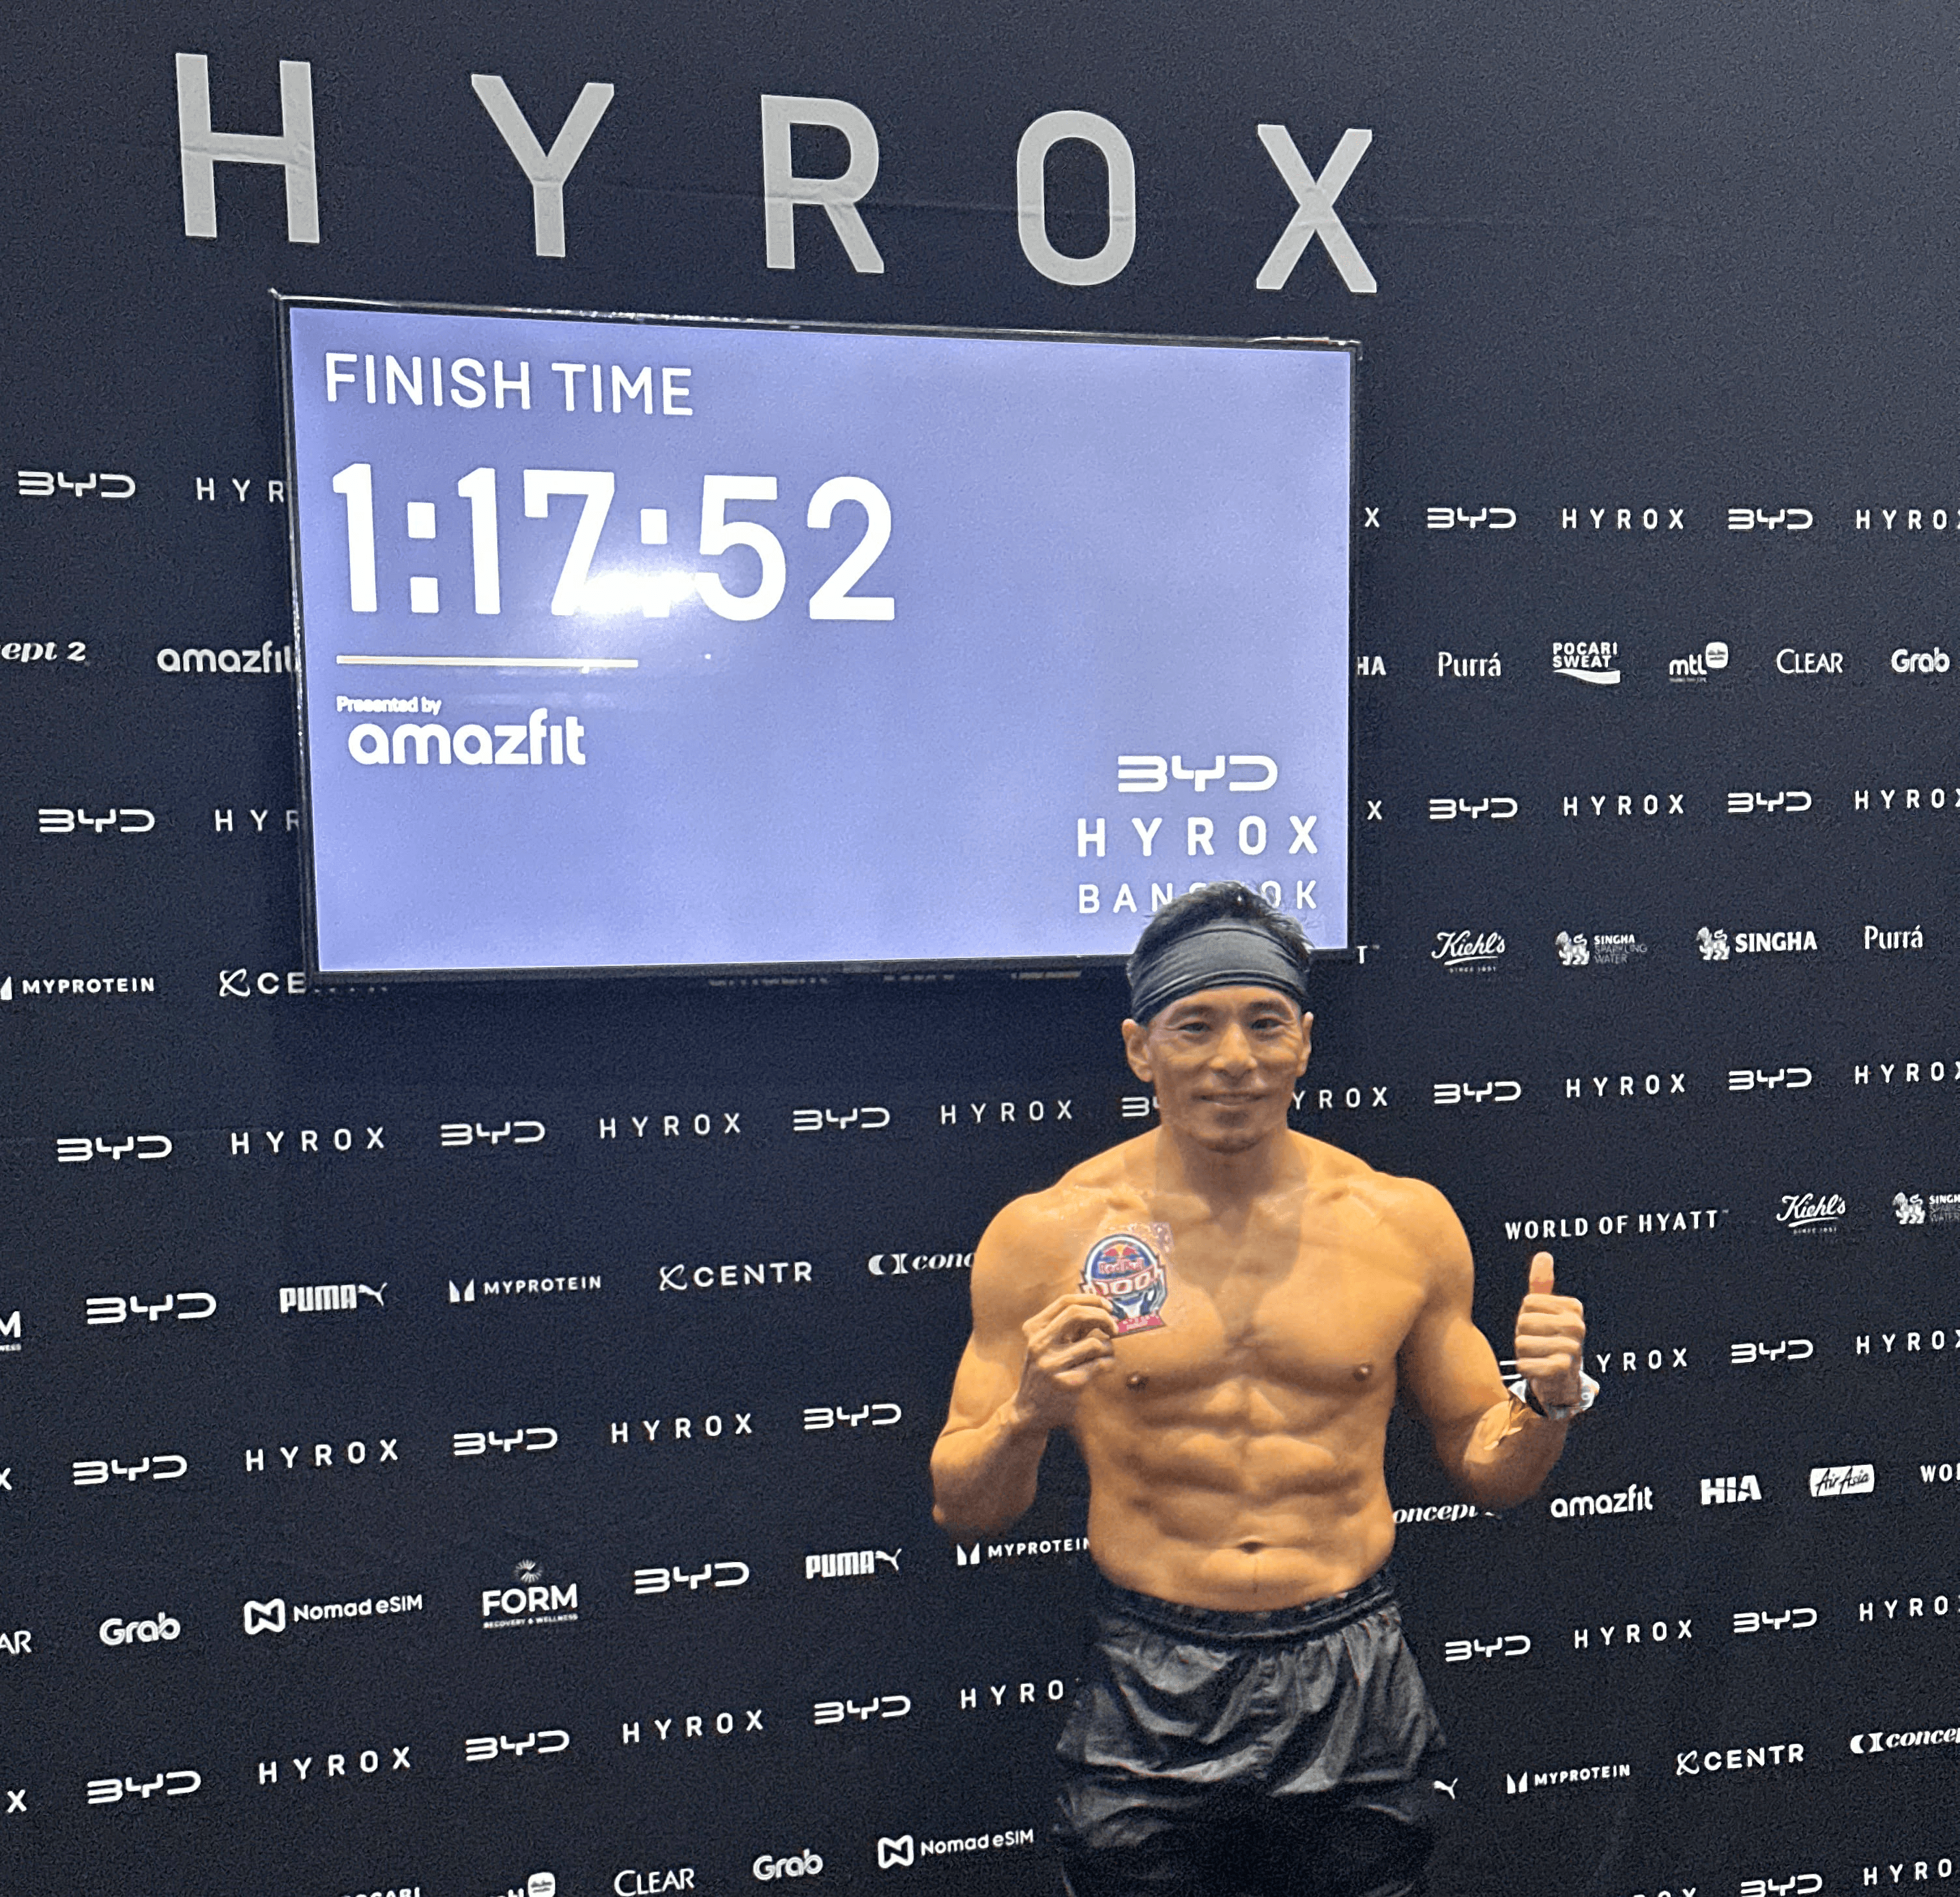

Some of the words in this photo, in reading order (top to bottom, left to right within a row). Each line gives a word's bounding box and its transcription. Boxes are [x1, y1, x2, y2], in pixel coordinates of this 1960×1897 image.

[175, 53, 1377, 293] HYROX
[326, 353, 531, 411] FINISH
[552, 362, 693, 416] TIME
[18, 471, 136, 498] BYD
[196, 477, 285, 503] HYR
[1427, 507, 1516, 529] BYD
[1563, 508, 1684, 530] HYROX
[1728, 508, 1813, 531] BYD
[1856, 509, 1960, 530] HYRO
[332, 463, 896, 622] 1:17:52
[67, 642, 85, 661] 2
[1553, 642, 1618, 655] POCARI
[1553, 656, 1613, 668] SWEAT
[1776, 648, 1843, 674] CLEAR
[1891, 647, 1950, 673] Grab
[1438, 652, 1501, 677] Purrá
[422, 697, 442, 716] by
[348, 708, 586, 766] amazfit
[1117, 755, 1278, 792] BYD
[1430, 798, 1518, 819] BYD
[1564, 794, 1683, 817] HYROX
[1727, 791, 1811, 813] BYD
[38, 809, 155, 833] BYD
[216, 809, 299, 832] HYR
[1076, 815, 1318, 857] HYROX
[1079, 880, 1317, 914] BANOK
[1431, 930, 1505, 959] Kiehl's
[1594, 934, 1635, 945] SINGHA
[1735, 931, 1817, 953] SINGHA
[1865, 925, 1923, 949] Purrá
[23, 977, 154, 994] MYPROTEIN
[57, 1135, 172, 1162] BYD
[231, 1127, 384, 1155] HYROX
[440, 1121, 545, 1146] BYD
[600, 1113, 740, 1138] HYROX
[793, 1107, 889, 1131] BYD
[942, 1100, 1072, 1124] HYROX
[1293, 1085, 1388, 1110] YROX
[1434, 1081, 1521, 1104] BYD
[1566, 1073, 1684, 1098] HYROX
[1729, 1068, 1812, 1090] BYD
[1776, 1193, 1845, 1221] Kiehl's
[1929, 1194, 1960, 1205] SINGH
[1505, 1218, 1587, 1239] WORLD
[1599, 1215, 1628, 1234] OF
[1639, 1210, 1718, 1234] HYATT
[694, 1260, 813, 1288] CENTR
[912, 1253, 974, 1271] conc
[280, 1284, 358, 1313] PUMA
[484, 1275, 601, 1294] MYPROTEIN
[87, 1293, 216, 1325] BYD
[1596, 1349, 1688, 1373] YROX
[1731, 1340, 1813, 1363] BYD
[73, 1455, 187, 1485] BYD
[246, 1439, 397, 1471] HYROX
[454, 1428, 557, 1455] BYD
[612, 1413, 752, 1443] HYROX
[803, 1404, 901, 1430] BYD
[1393, 1504, 1478, 1524] oncept
[1551, 1484, 1652, 1518] amazfit
[635, 1562, 749, 1594] BYD
[805, 1550, 875, 1579] PUMA
[294, 1599, 371, 1622] Nomad
[375, 1595, 422, 1614] eSIM
[482, 1583, 578, 1616] FORM
[100, 1612, 180, 1645] Grab
[1445, 1636, 1531, 1662] BYD
[1575, 1619, 1692, 1649] HYROX
[1733, 1608, 1817, 1633] BYD
[1860, 1595, 1960, 1621] HYRO
[87, 1771, 201, 1804] BYD
[259, 1746, 411, 1784] HYROX
[466, 1730, 569, 1761] BYD
[623, 1709, 763, 1743] HYROX
[814, 1696, 910, 1724] BYD
[961, 1680, 1063, 1709] HYRO
[1886, 1728, 1960, 1749] conce
[1703, 1743, 1804, 1771] CENTR
[1535, 1765, 1630, 1786] MYPROTEIN
[921, 1834, 988, 1856] Nomad
[992, 1829, 1033, 1847] eSIM
[753, 1849, 823, 1881] Grab
[1864, 1859, 1952, 1886] HYRO
[614, 1868, 695, 1897] CLEAR
